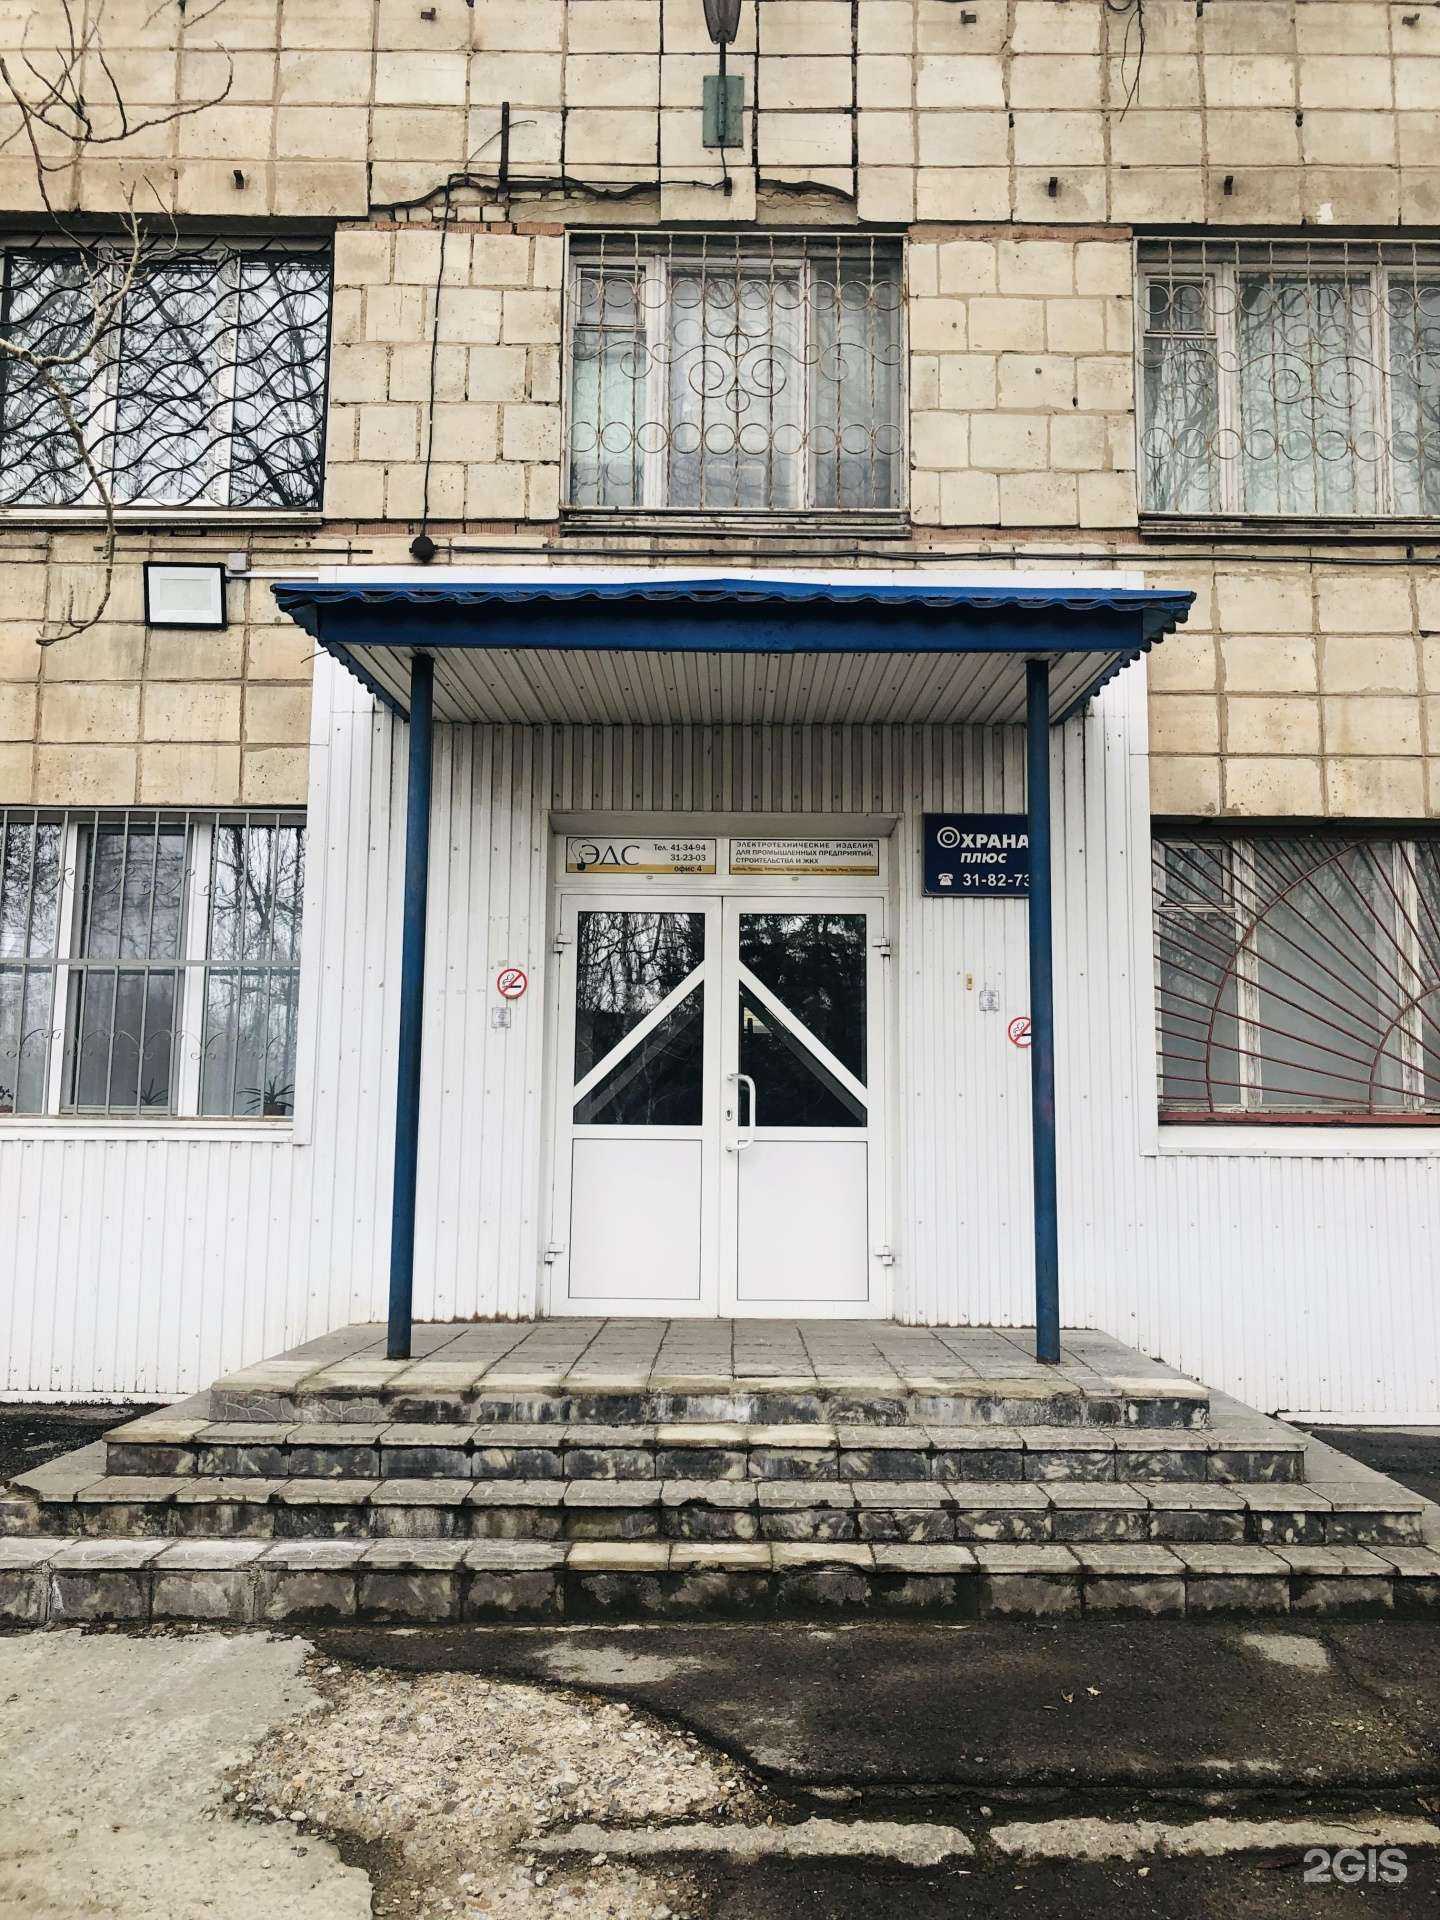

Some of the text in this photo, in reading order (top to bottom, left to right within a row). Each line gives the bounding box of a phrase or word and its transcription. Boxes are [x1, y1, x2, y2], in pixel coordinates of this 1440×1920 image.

[937, 826, 1029, 849] ОХРАНА
[670, 843, 706, 851] 41-34-94
[735, 841, 830, 849] ЭЛЕКТРОТЕХНИЧЕСКИЕ
[581, 844, 640, 866] ЭДС
[670, 853, 706, 862] 31-23-03
[673, 865, 696, 874] офис
